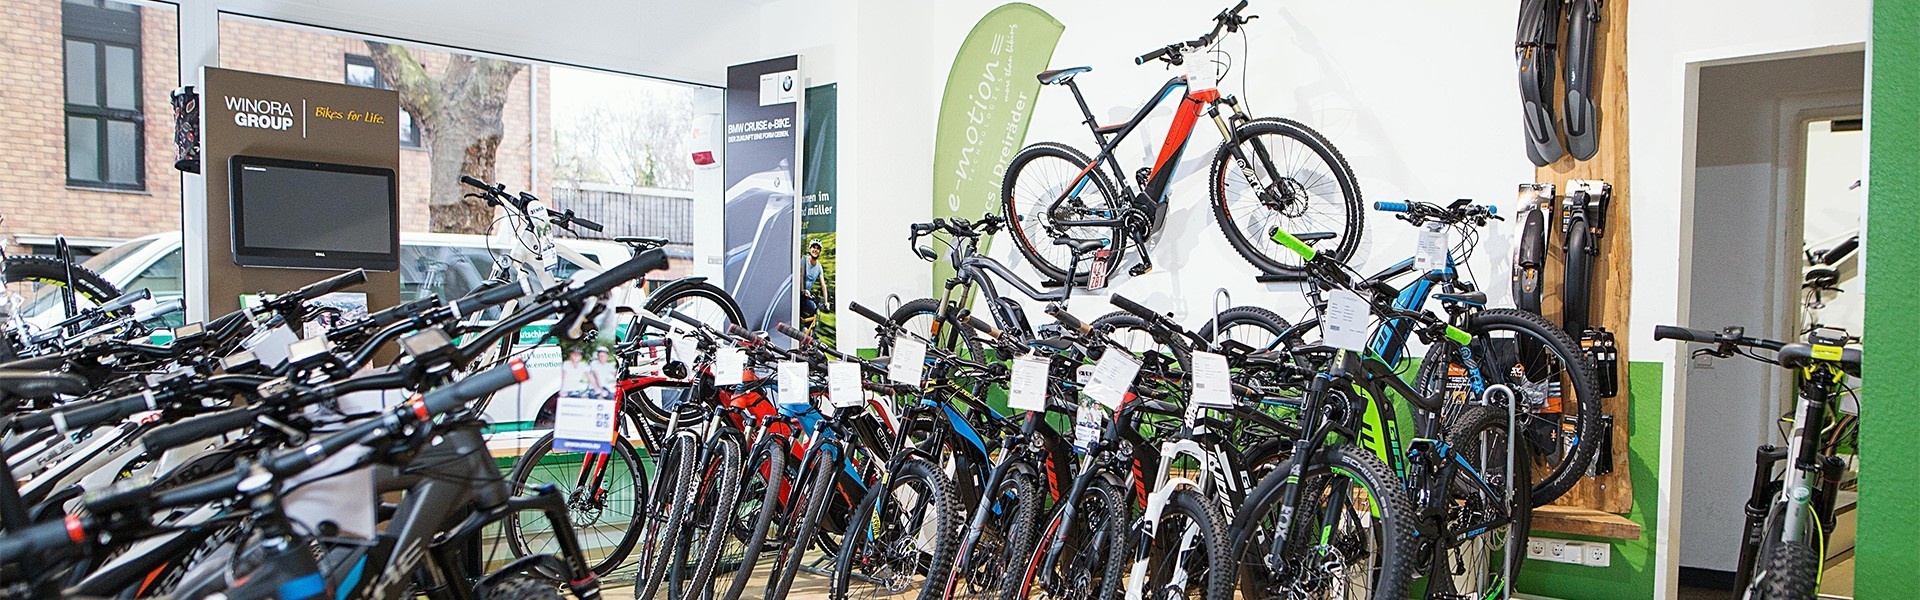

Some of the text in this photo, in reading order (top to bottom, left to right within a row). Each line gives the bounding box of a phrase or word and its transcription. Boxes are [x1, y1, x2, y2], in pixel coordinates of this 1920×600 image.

[224, 95, 294, 117] WINORA
[315, 106, 385, 125] Bikes for Life.
[234, 112, 294, 131] GROUP
[728, 123, 744, 135] BMW
[744, 120, 767, 132] CRUISE
[948, 60, 999, 212] e-motion
[992, 91, 1027, 178] Dreiräder
[818, 191, 830, 202] im
[807, 204, 833, 216] müller
[1341, 455, 1389, 518] SCHWALBE
[1274, 505, 1294, 540] FOX
